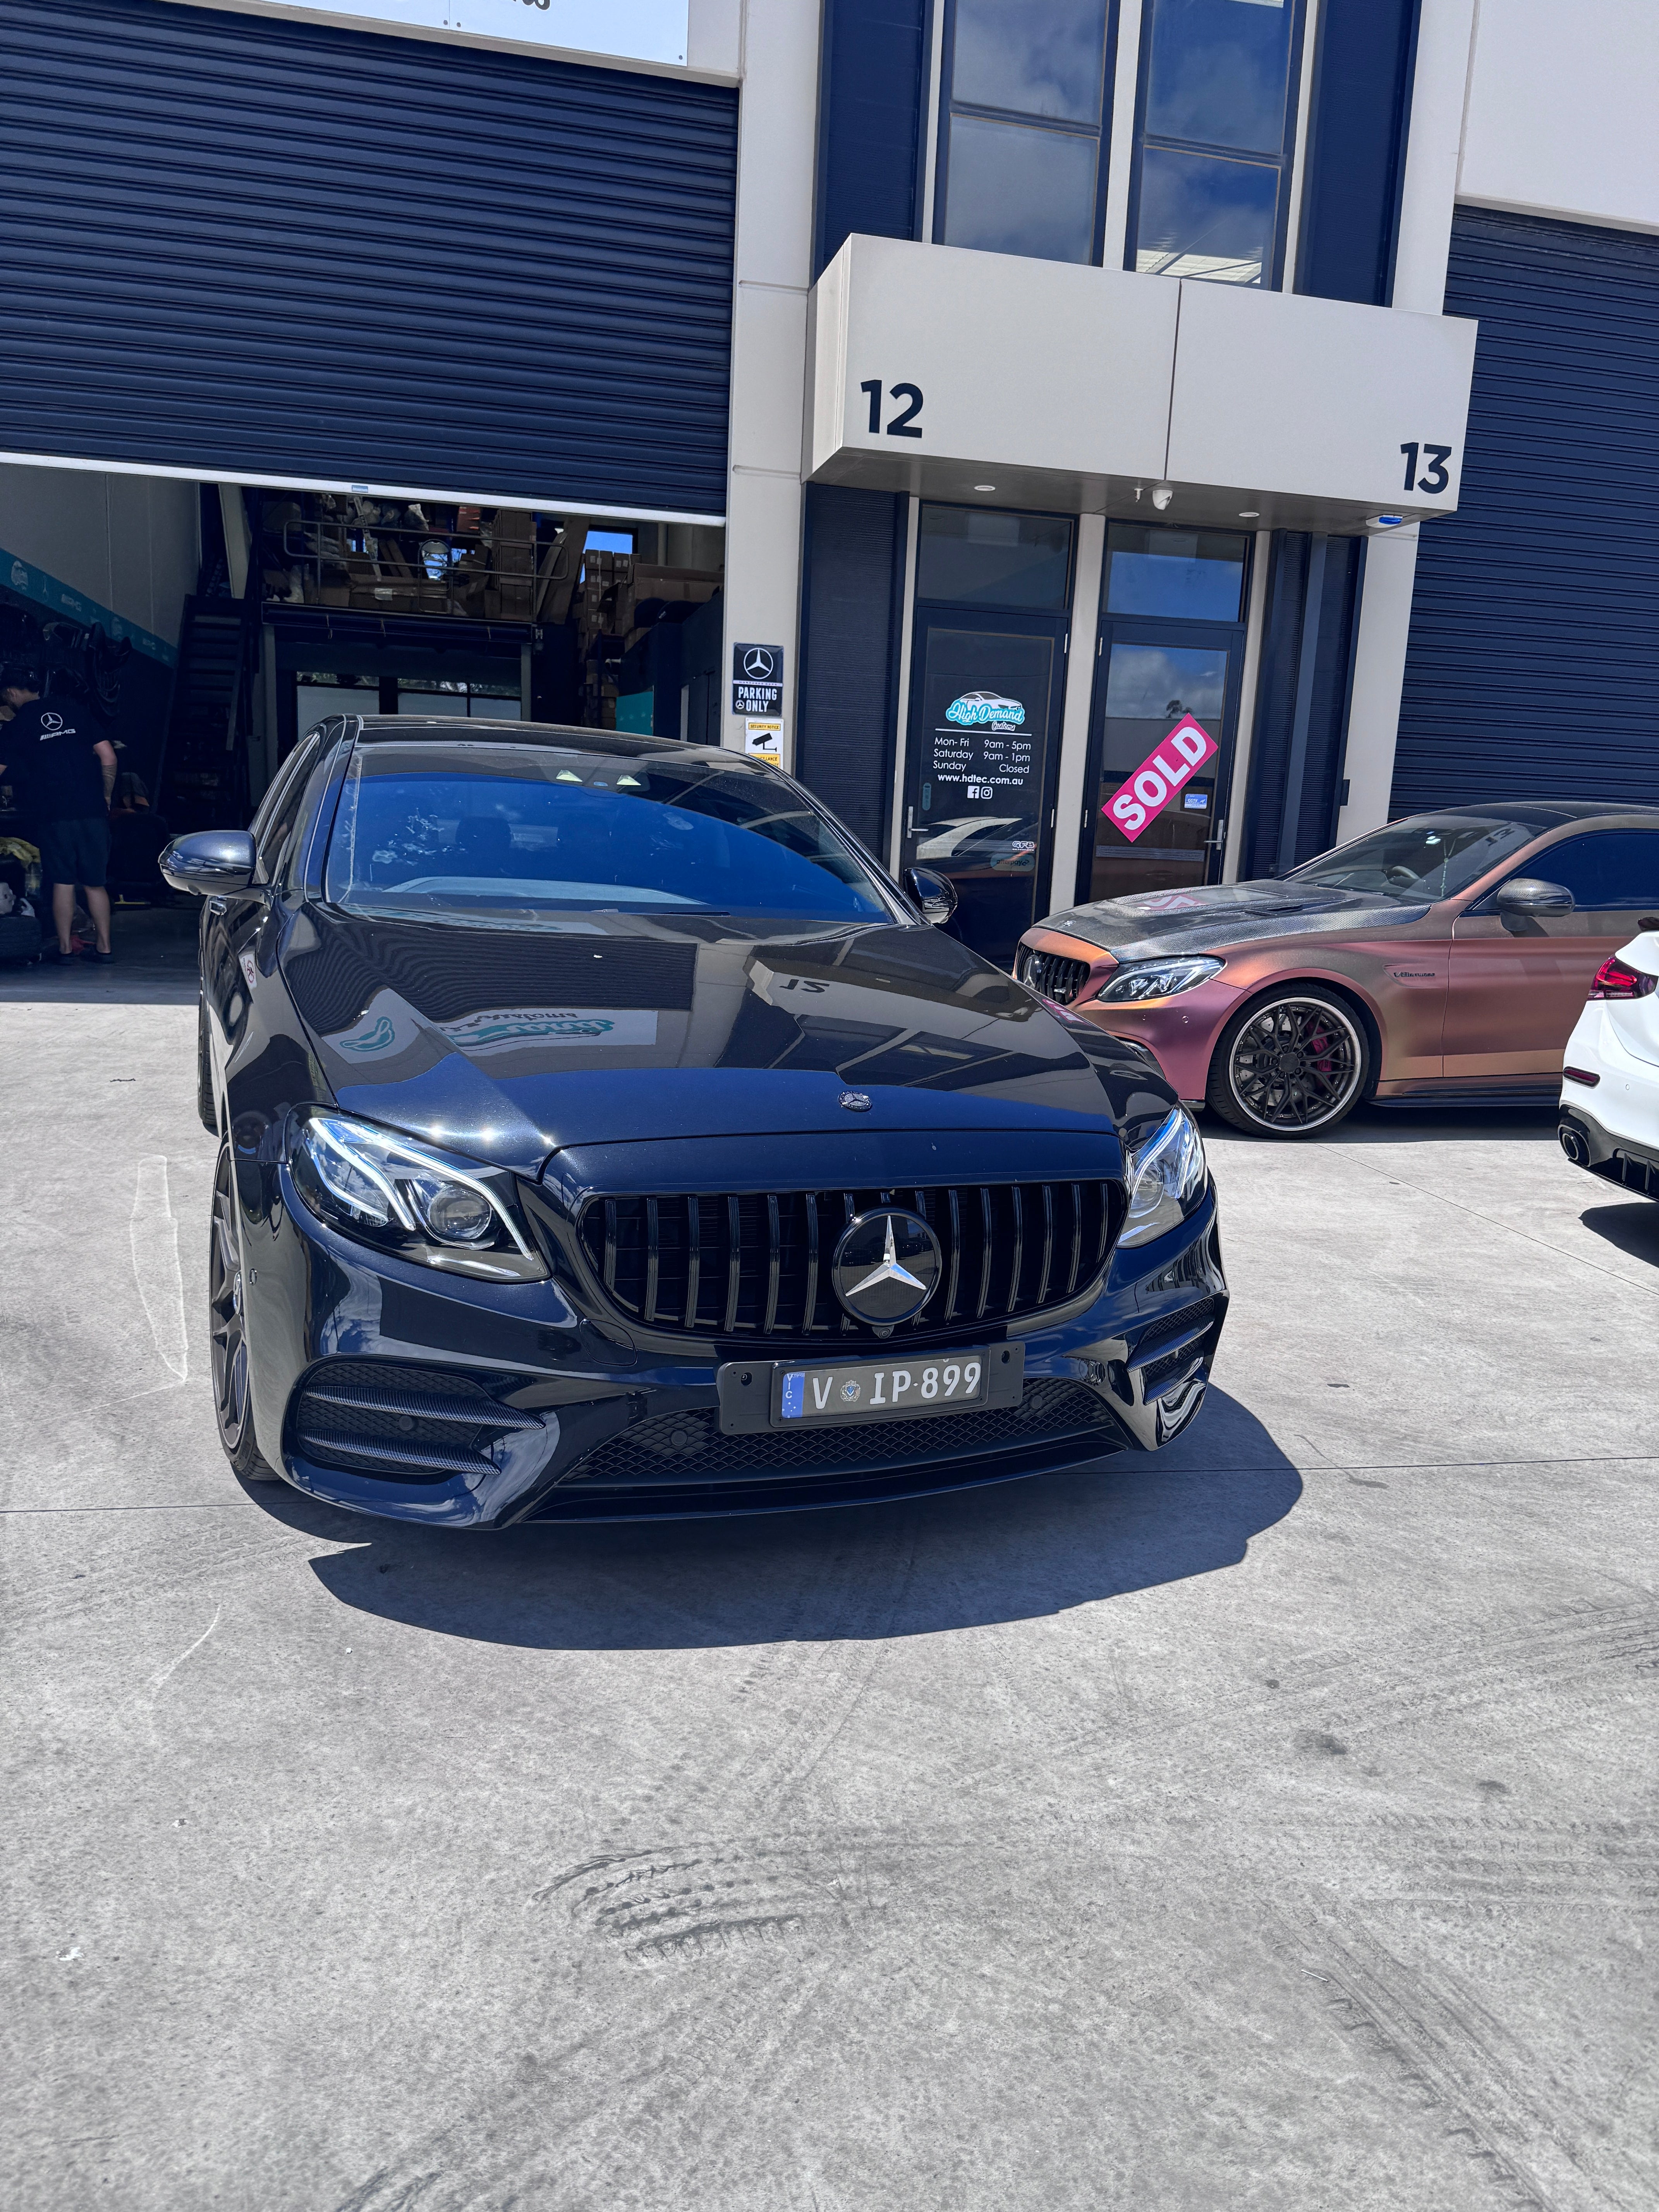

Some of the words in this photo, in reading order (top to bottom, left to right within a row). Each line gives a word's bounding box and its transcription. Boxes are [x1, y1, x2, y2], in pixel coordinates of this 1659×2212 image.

[860, 379, 924, 438] 12
[1400, 442, 1452, 494] 13
[738, 687, 777, 701] PARKING
[746, 699, 769, 712] ONLY
[948, 702, 978, 723] High
[979, 705, 1023, 722] Demand
[960, 738, 969, 747] Fri
[984, 739, 1004, 749] 9am
[1011, 741, 1031, 751] 5pm
[934, 748, 974, 761] Saturday
[983, 751, 1003, 760] 9am
[1012, 752, 1030, 763] 1pm
[933, 760, 966, 772] Sunday
[999, 764, 1030, 773] Closed
[938, 774, 1024, 785] www.hdtec.com.au
[1113, 726, 1207, 830] SOLD
[1012, 840, 1035, 848] GFB
